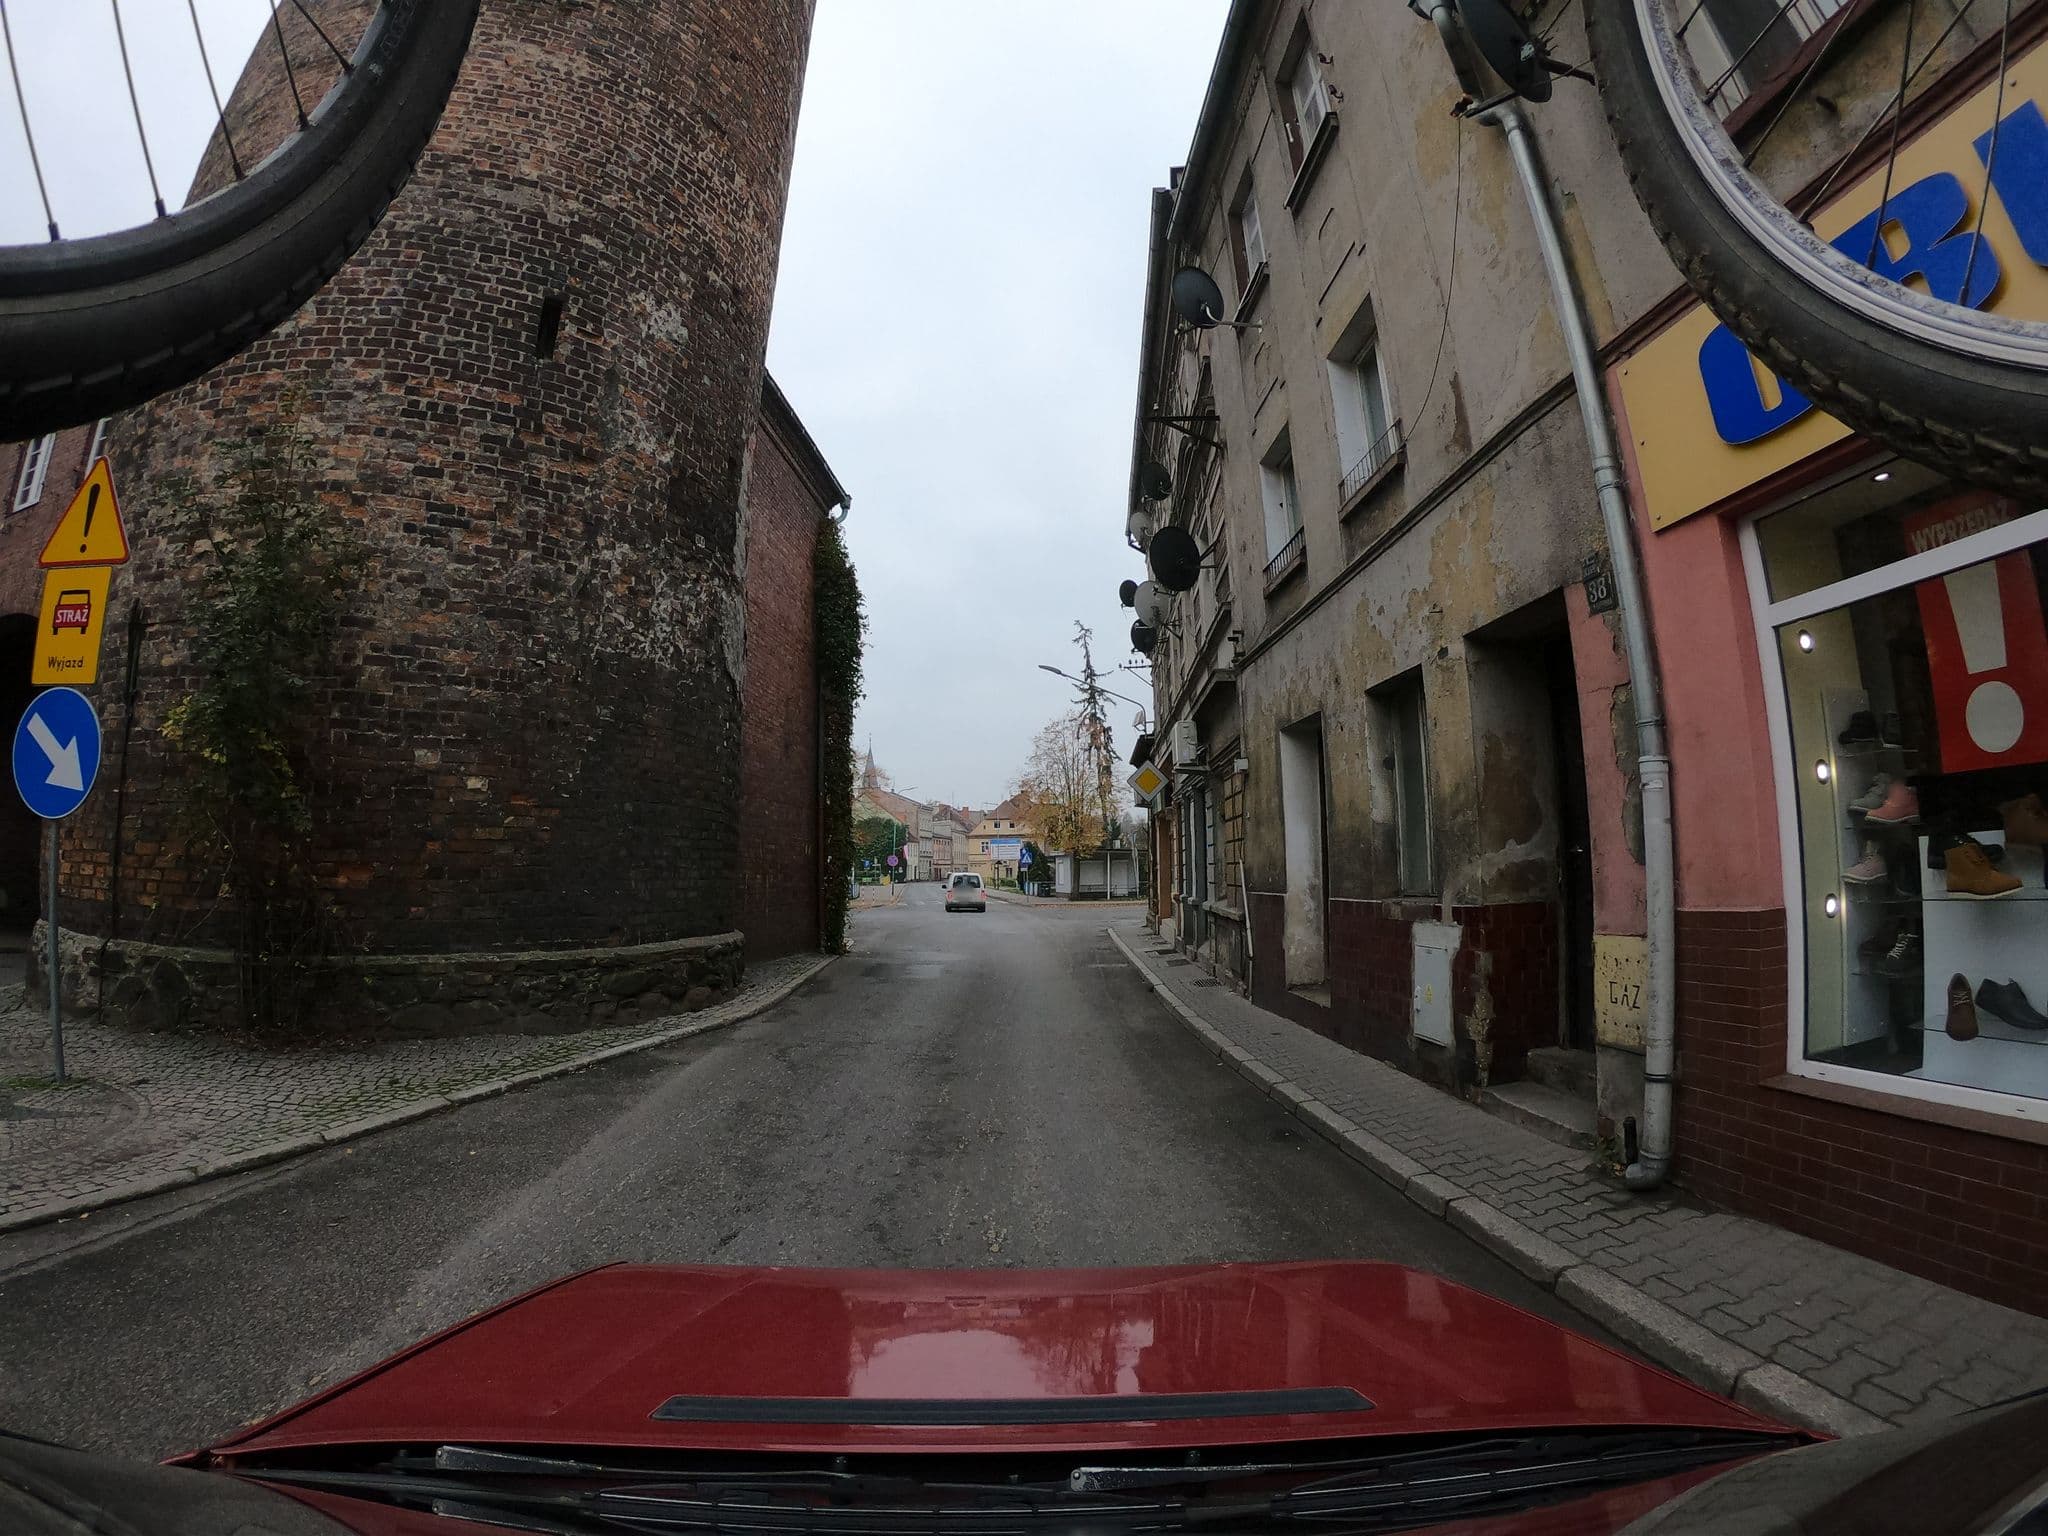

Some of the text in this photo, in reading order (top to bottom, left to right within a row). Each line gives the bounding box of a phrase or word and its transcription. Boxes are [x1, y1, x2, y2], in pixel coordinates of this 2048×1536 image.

[56, 605, 89, 623] STRAŻ
[48, 656, 84, 672] Wyjazd
[1609, 981, 1641, 1009] GAZ
